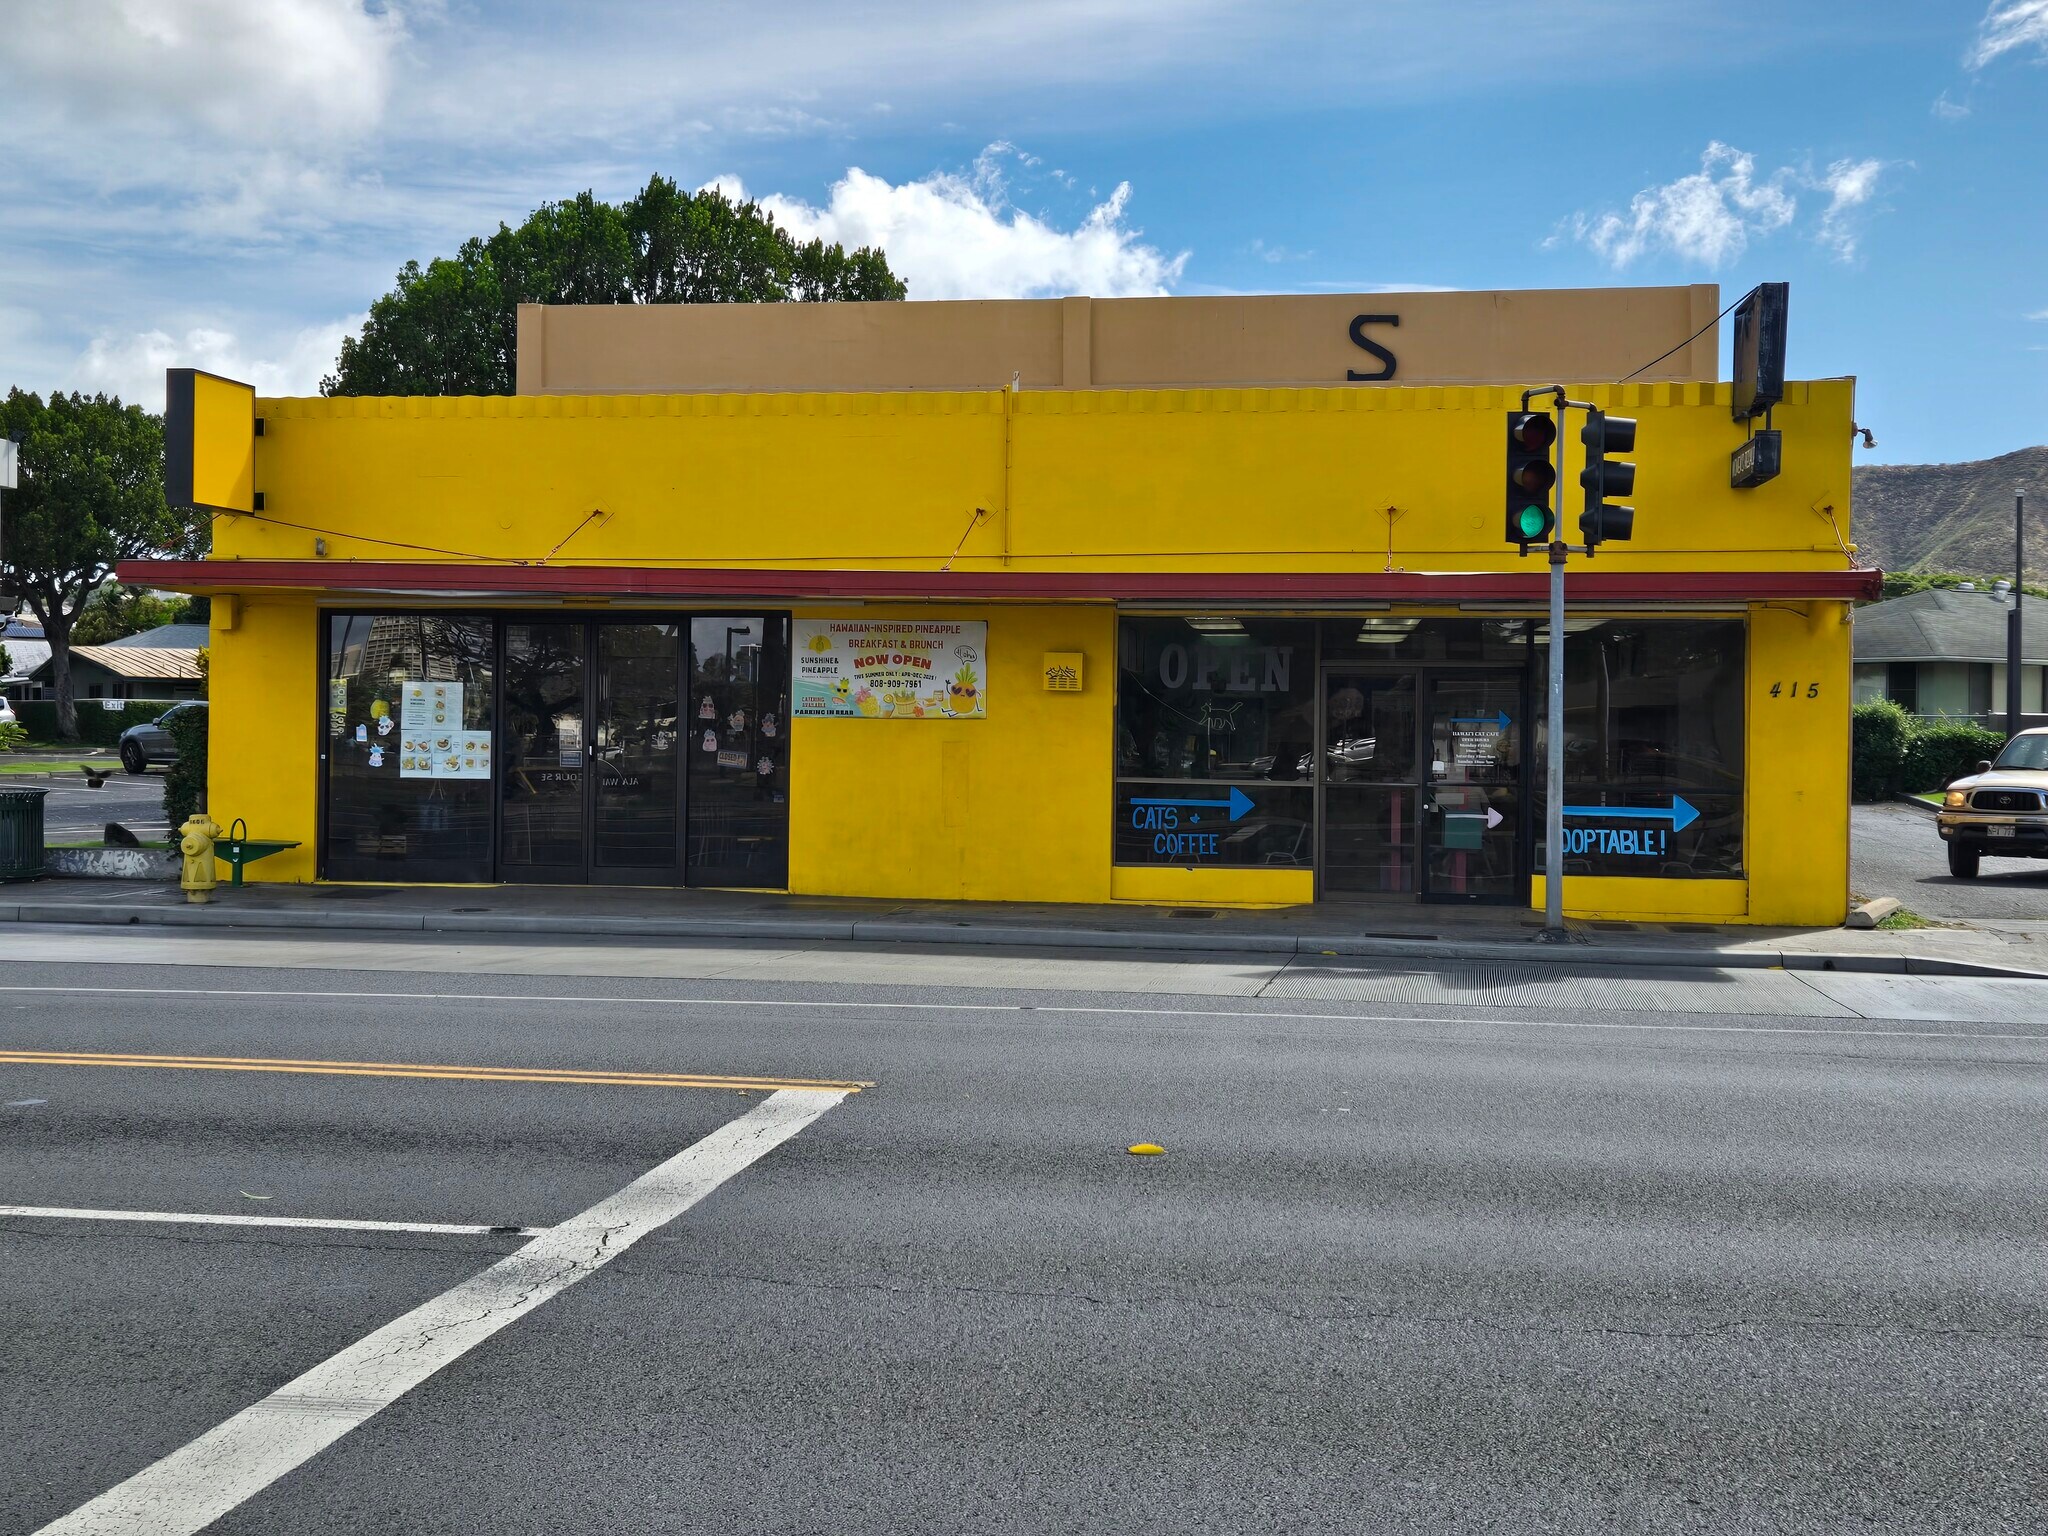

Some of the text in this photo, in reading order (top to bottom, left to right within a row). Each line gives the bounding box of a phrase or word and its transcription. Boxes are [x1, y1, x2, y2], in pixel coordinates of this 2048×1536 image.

[1347, 314, 1399, 381] S
[829, 623, 961, 634] HAWAIIAN-INSPIRED PINEAPPLE
[848, 639, 944, 649] BREAKFAST & BRUNCH
[801, 666, 838, 674] PINEAPPLE
[853, 654, 932, 670] NOW OPEN
[1158, 643, 1294, 691] OPEN
[1769, 681, 1820, 698] 415
[104, 700, 124, 710] Exit
[1132, 806, 1179, 829] CATS
[1154, 833, 1219, 855] COFFEE
[1562, 829, 1667, 855] DOPTABLE!
